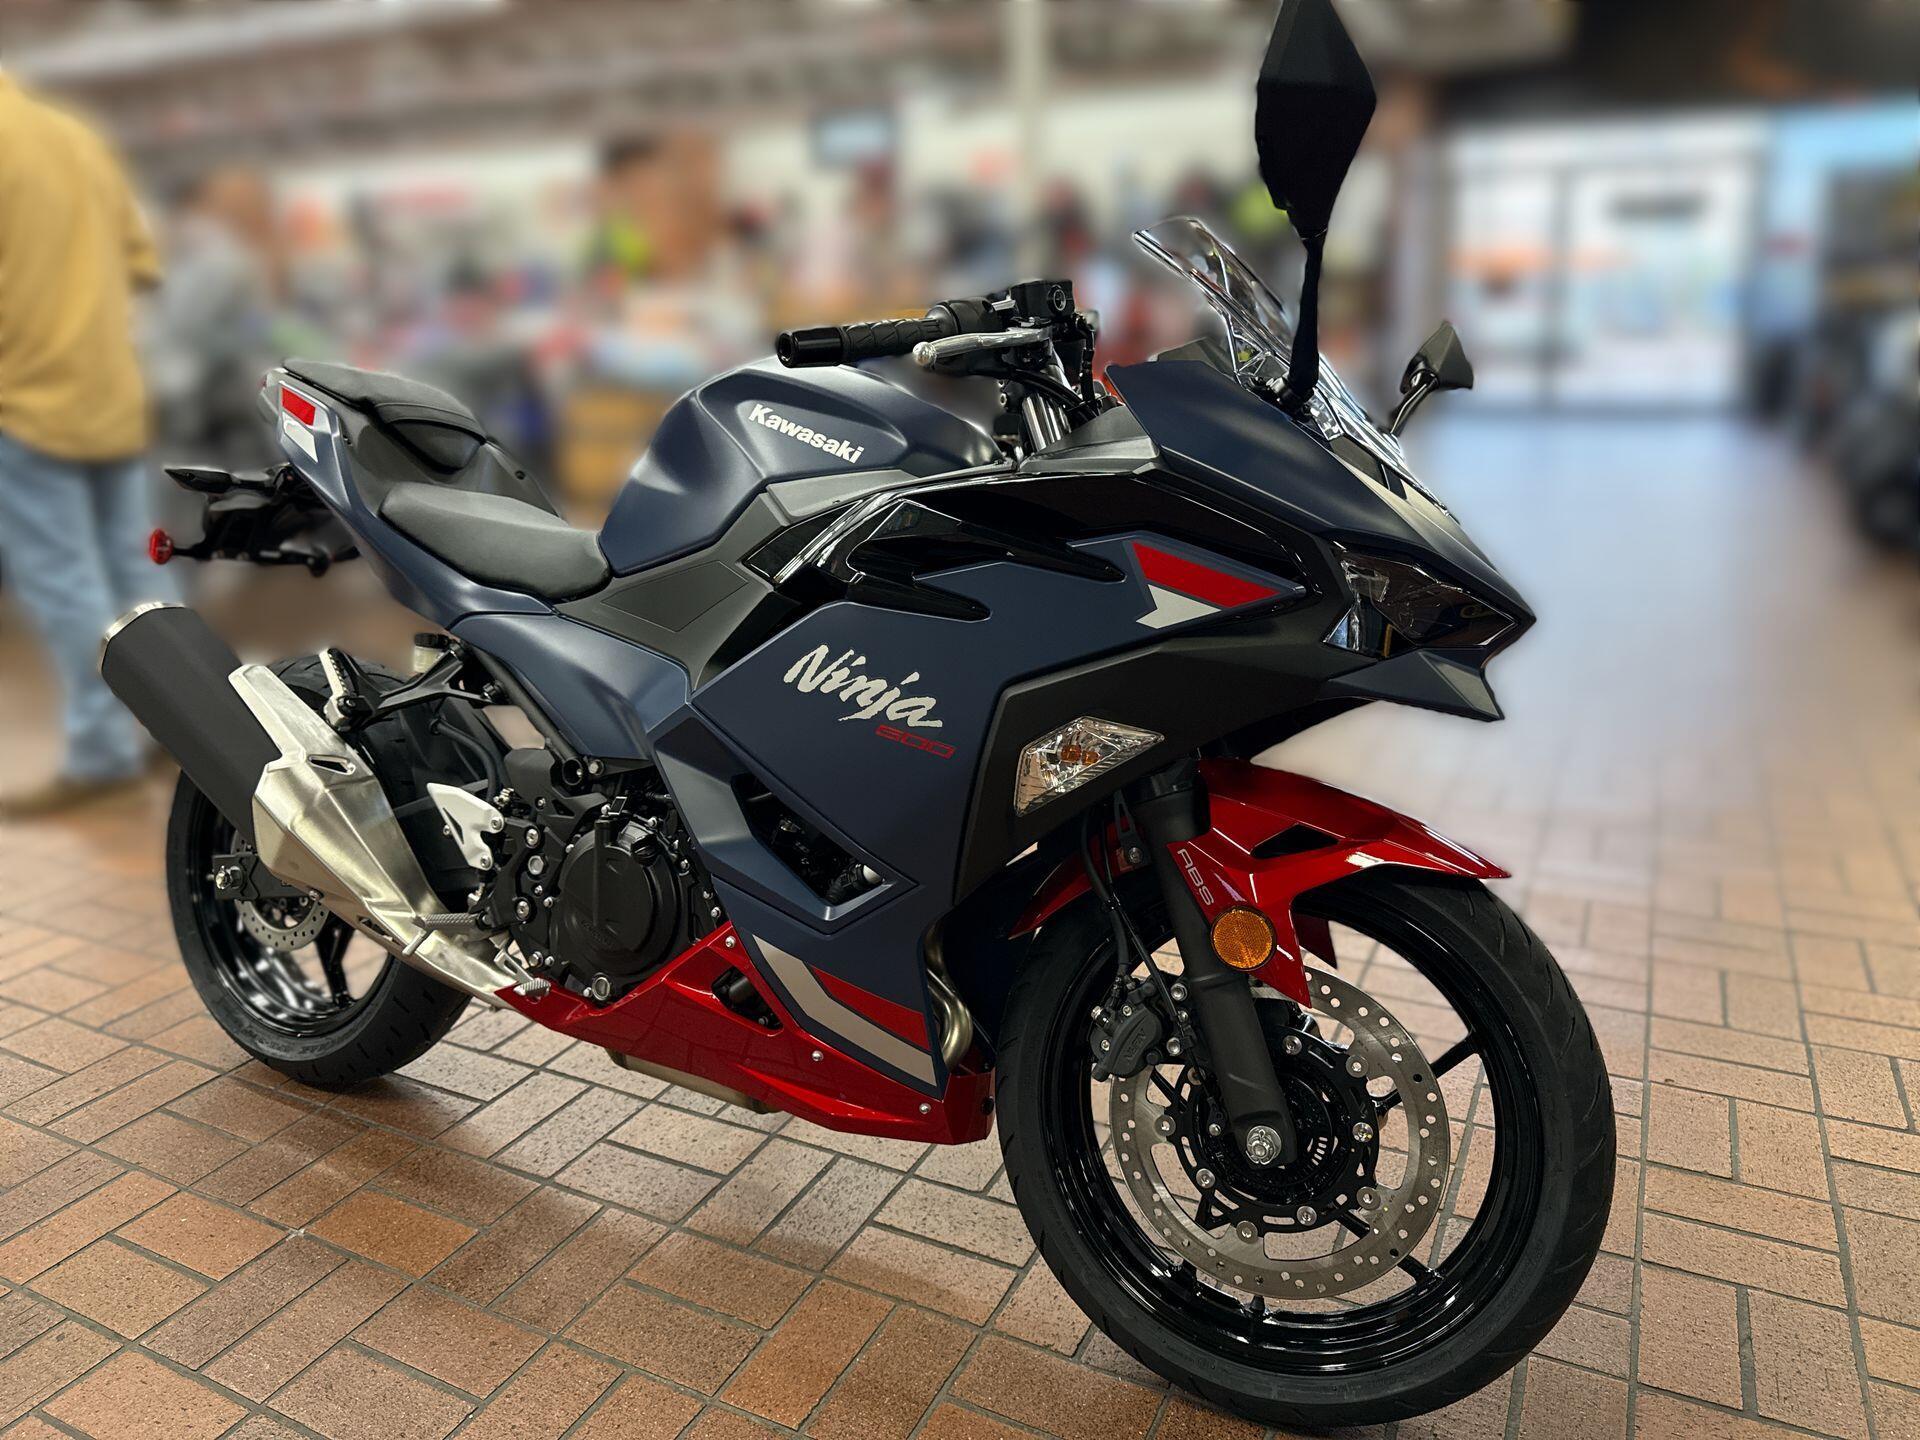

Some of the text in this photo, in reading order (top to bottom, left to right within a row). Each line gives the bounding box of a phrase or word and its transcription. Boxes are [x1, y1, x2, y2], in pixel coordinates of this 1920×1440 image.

[748, 403, 865, 464] Kawasaki
[783, 644, 943, 728] Ninja
[1177, 848, 1215, 906] ABS
